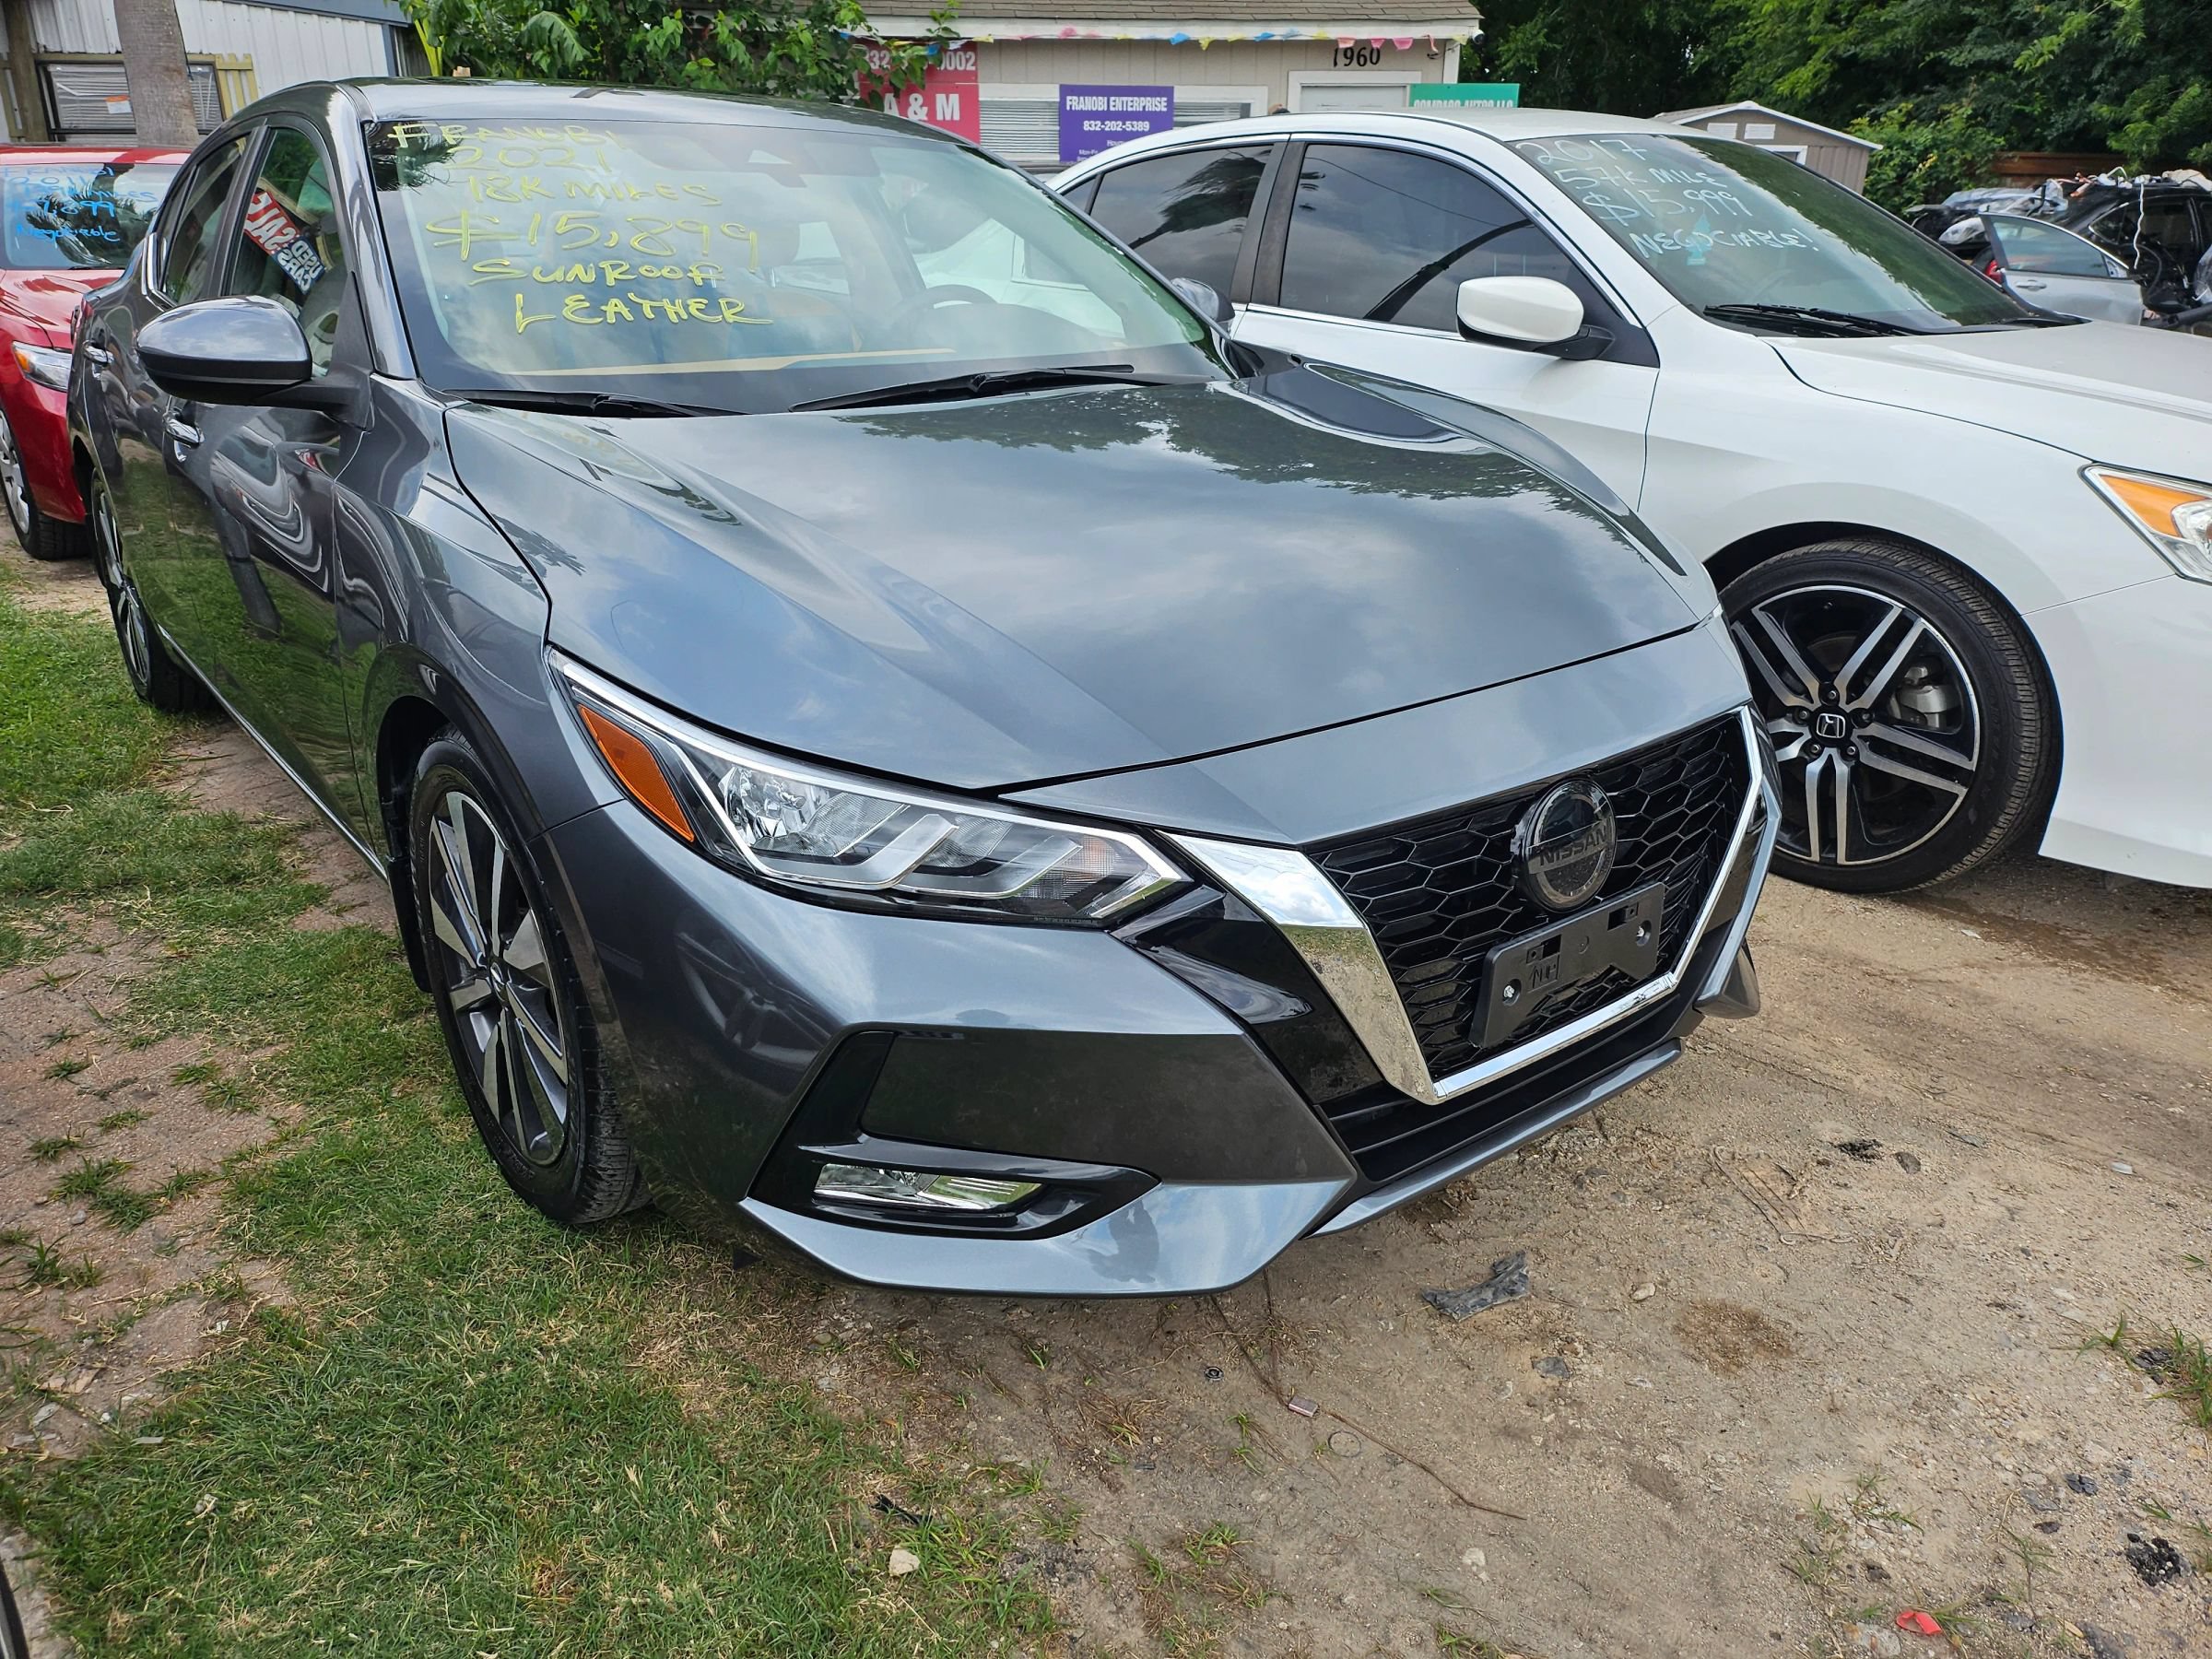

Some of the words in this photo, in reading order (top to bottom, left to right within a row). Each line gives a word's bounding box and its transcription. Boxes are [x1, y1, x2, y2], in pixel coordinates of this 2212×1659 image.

[1334, 46, 1381, 67] 1960
[884, 93, 900, 117] A
[907, 93, 928, 121] &
[935, 93, 960, 121] M
[1065, 96, 1108, 111] FRANOBI
[1109, 96, 1168, 112] ENTERPRISE
[388, 124, 626, 149] FRANOBI
[1083, 120, 1150, 132] 832-202-5389
[443, 146, 612, 172] 2021
[1516, 139, 1649, 165] 2017
[563, 181, 723, 207] MILES
[426, 209, 759, 274] $15,899
[468, 258, 725, 287] SUNROOF
[514, 292, 774, 335] LEATHER
[1539, 823, 1607, 866] NISSAN
